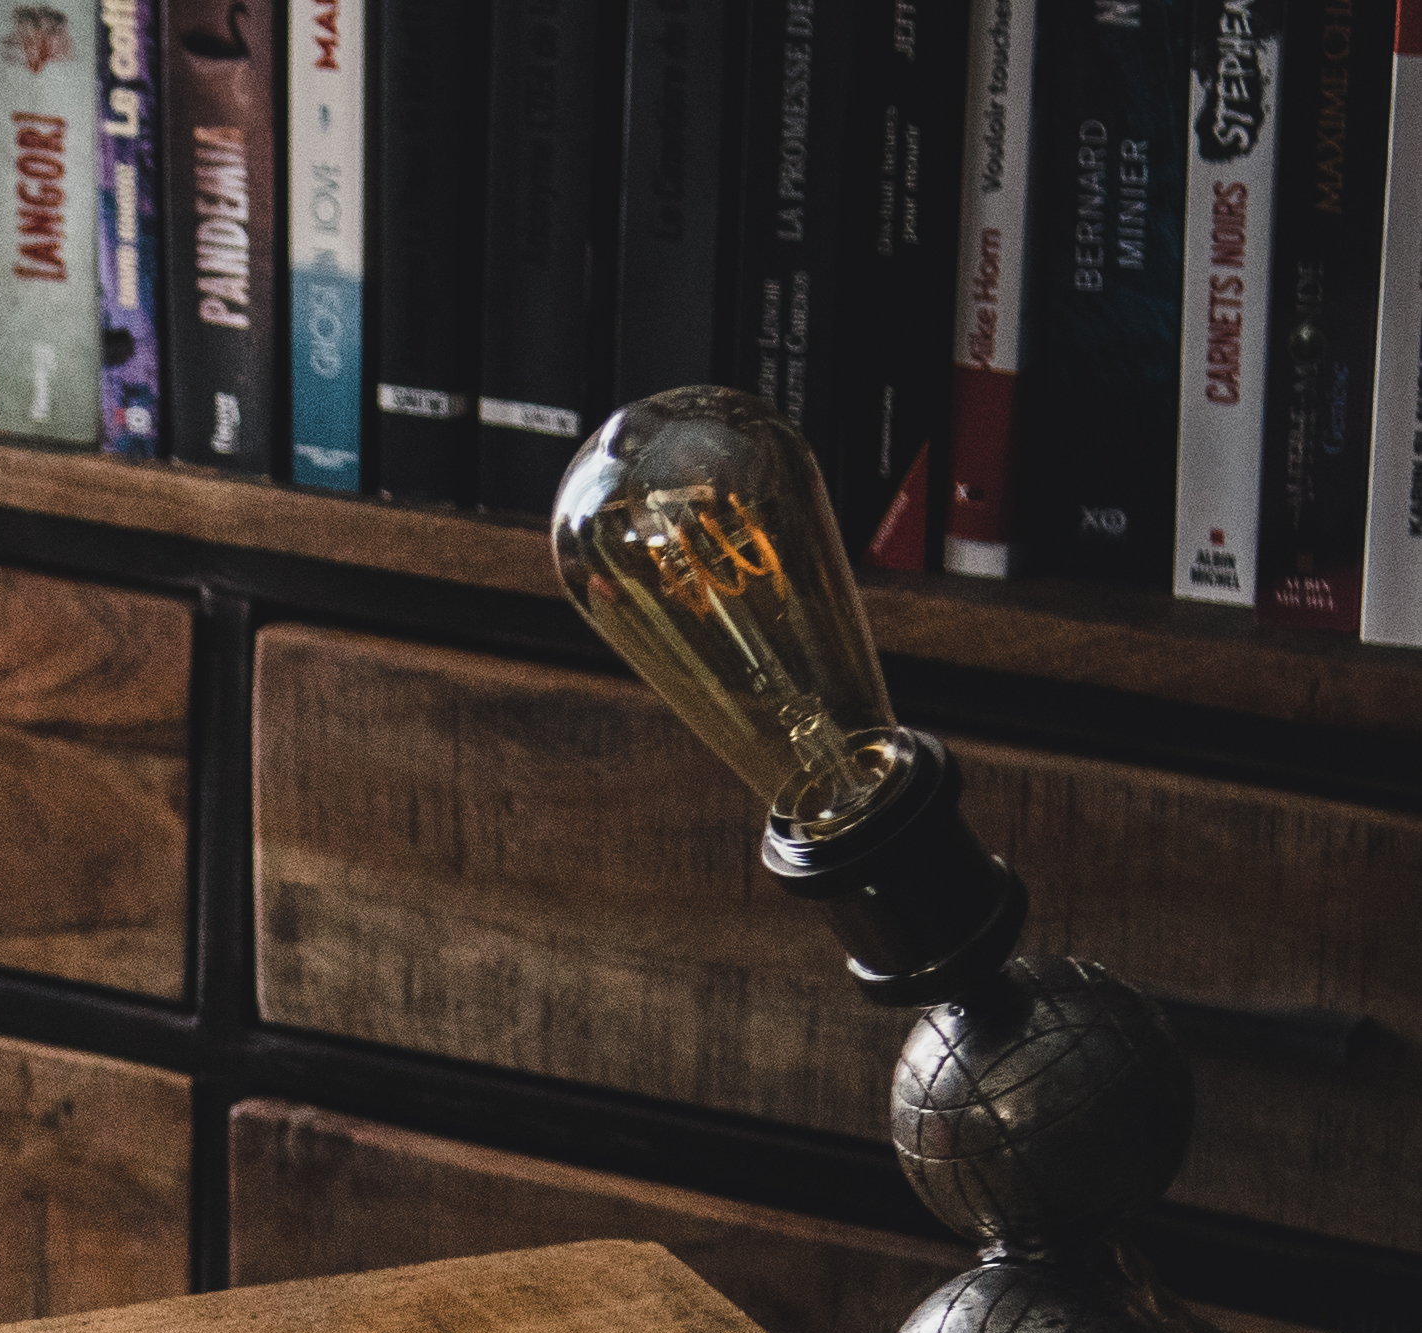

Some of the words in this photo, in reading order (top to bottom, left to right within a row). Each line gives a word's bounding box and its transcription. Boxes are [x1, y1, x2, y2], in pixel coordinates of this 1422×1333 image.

[778, 42, 812, 200] PROMESSE
[981, 98, 1006, 195] Vouloir
[1313, 68, 1349, 214] MAXIME
[193, 126, 250, 331] PANDEMIA
[311, 158, 343, 237] LOVE
[776, 206, 804, 242] LA
[1074, 118, 1109, 292] BERNARD
[1117, 138, 1149, 270] MINIER
[1212, 181, 1248, 268] NOIRS
[971, 227, 1002, 304] Horn
[310, 282, 343, 379] GHOST
[1206, 274, 1244, 405] CARNETS
[1189, 564, 1240, 592] MICHEL
[1196, 550, 1236, 569] ALBIN
